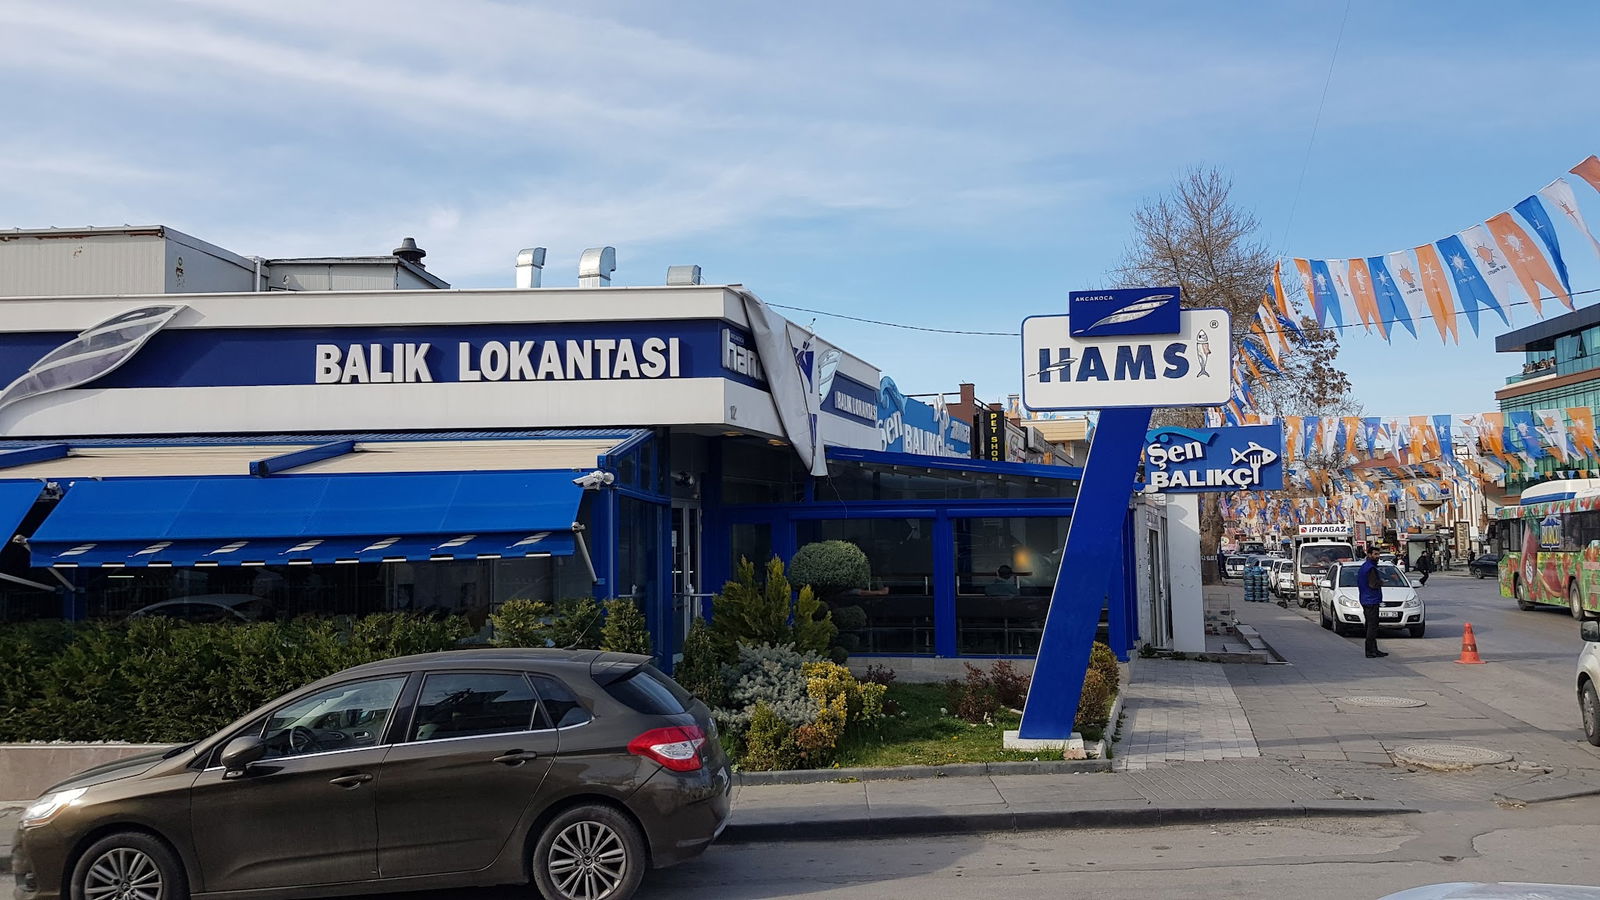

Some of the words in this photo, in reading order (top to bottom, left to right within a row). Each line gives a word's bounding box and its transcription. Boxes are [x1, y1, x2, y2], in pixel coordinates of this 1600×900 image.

[315, 342, 433, 384] BALIK
[459, 338, 680, 382] LOKANTASI
[834, 390, 852, 414] BALIK
[989, 413, 998, 434] PET
[1147, 440, 1204, 470] Şen
